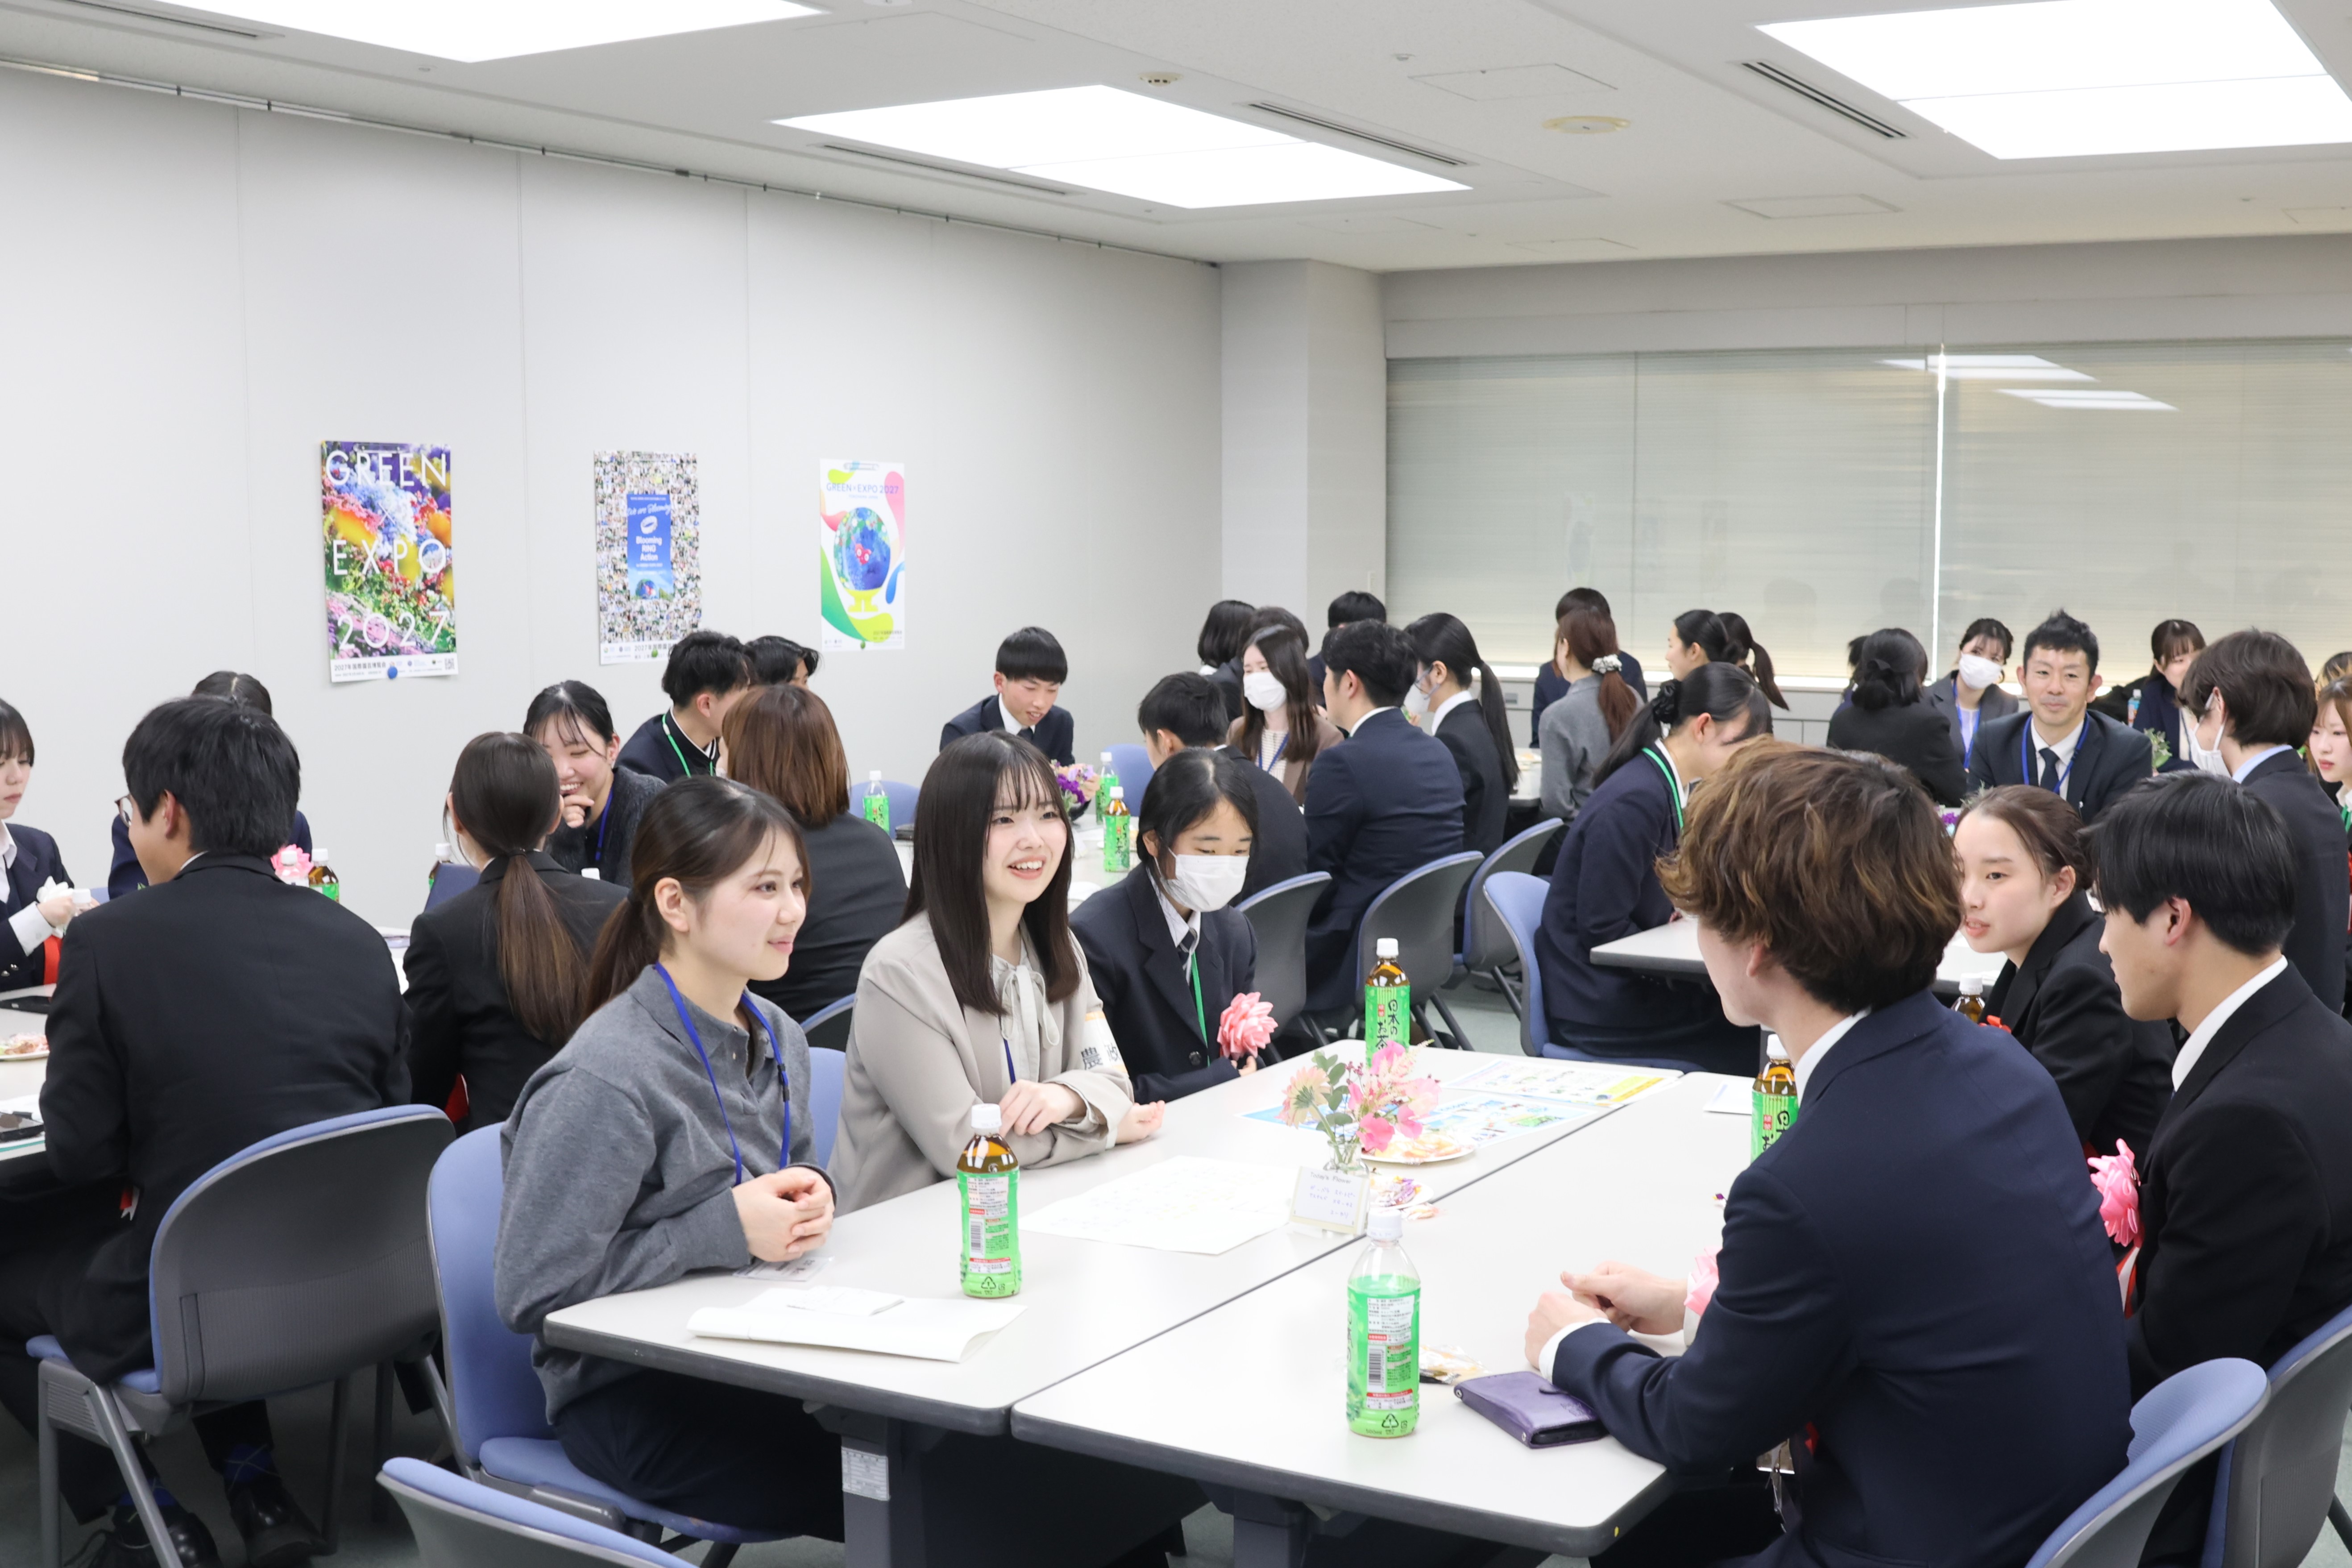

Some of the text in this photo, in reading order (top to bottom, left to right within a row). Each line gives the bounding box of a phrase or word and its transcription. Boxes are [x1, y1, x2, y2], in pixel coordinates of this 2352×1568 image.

[325, 450, 447, 487] GREEN
[879, 485, 899, 494] 2027
[636, 535, 662, 546] Blooming
[641, 544, 656, 552] RING
[333, 538, 447, 575] EXPO
[640, 553, 658, 561] Action
[337, 611, 447, 650] 2027
[1388, 999, 1400, 1035] 日本の
[1376, 1019, 1389, 1049] お茶
[1311, 1172, 1352, 1184] Today's Flower
